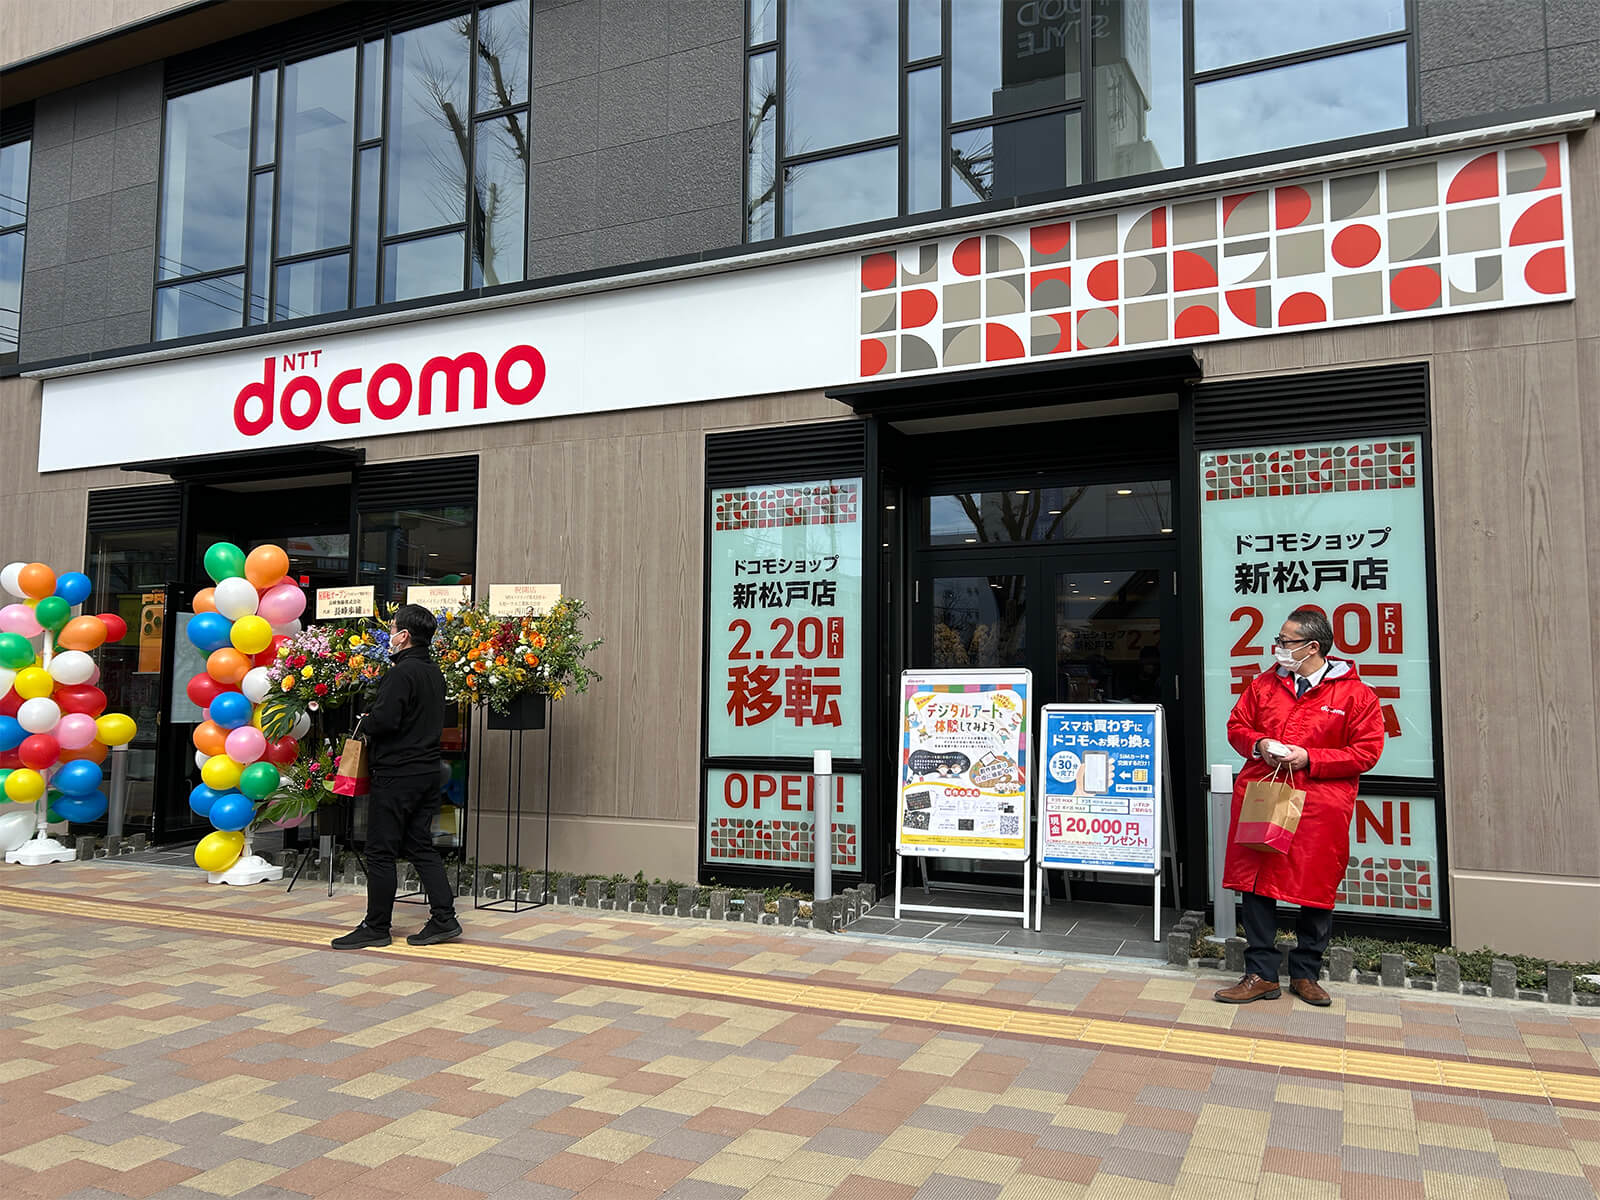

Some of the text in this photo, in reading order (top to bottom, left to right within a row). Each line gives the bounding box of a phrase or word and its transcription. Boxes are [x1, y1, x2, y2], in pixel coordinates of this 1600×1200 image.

[283, 350, 322, 372] NTT
[233, 344, 546, 436] docomo
[1236, 526, 1392, 555] ドコモショップ
[735, 554, 840, 577] ドコモショップ
[1234, 557, 1389, 595] 新松戸店
[733, 580, 837, 609] 新松戸店
[728, 616, 840, 660] 2.20 FRI
[1384, 607, 1396, 650] FRI
[727, 664, 842, 728] 移転
[935, 720, 995, 733] 体験してみよう
[1059, 719, 1143, 733] スマホ買わずに
[1052, 734, 1152, 748] ドコモへお乗り換え
[724, 773, 844, 812] OPE!
[1103, 835, 1148, 847] プレゼント!
